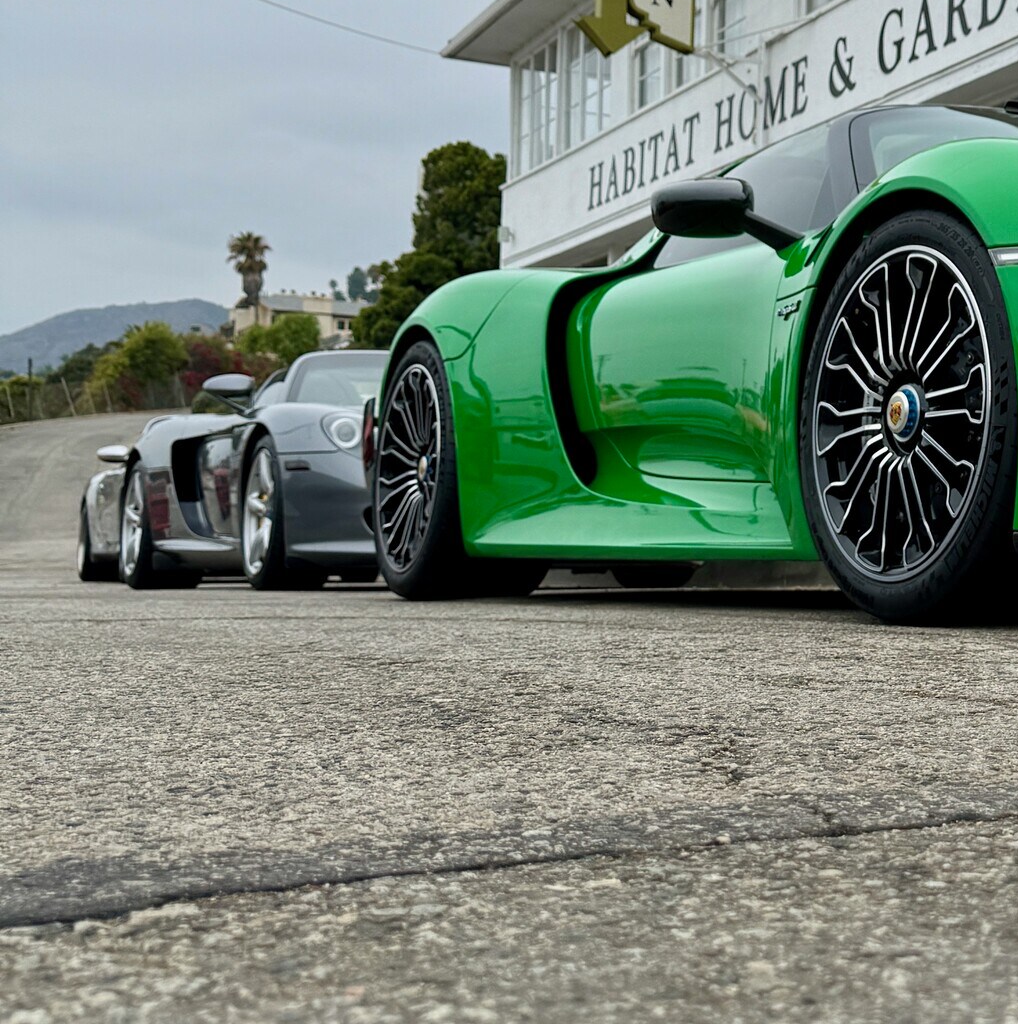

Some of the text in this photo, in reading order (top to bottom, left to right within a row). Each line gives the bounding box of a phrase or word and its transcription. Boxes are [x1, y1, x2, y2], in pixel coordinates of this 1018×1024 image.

[587, 112, 701, 211] HABITAT
[714, 55, 808, 154] HOME
[828, 37, 857, 98] &
